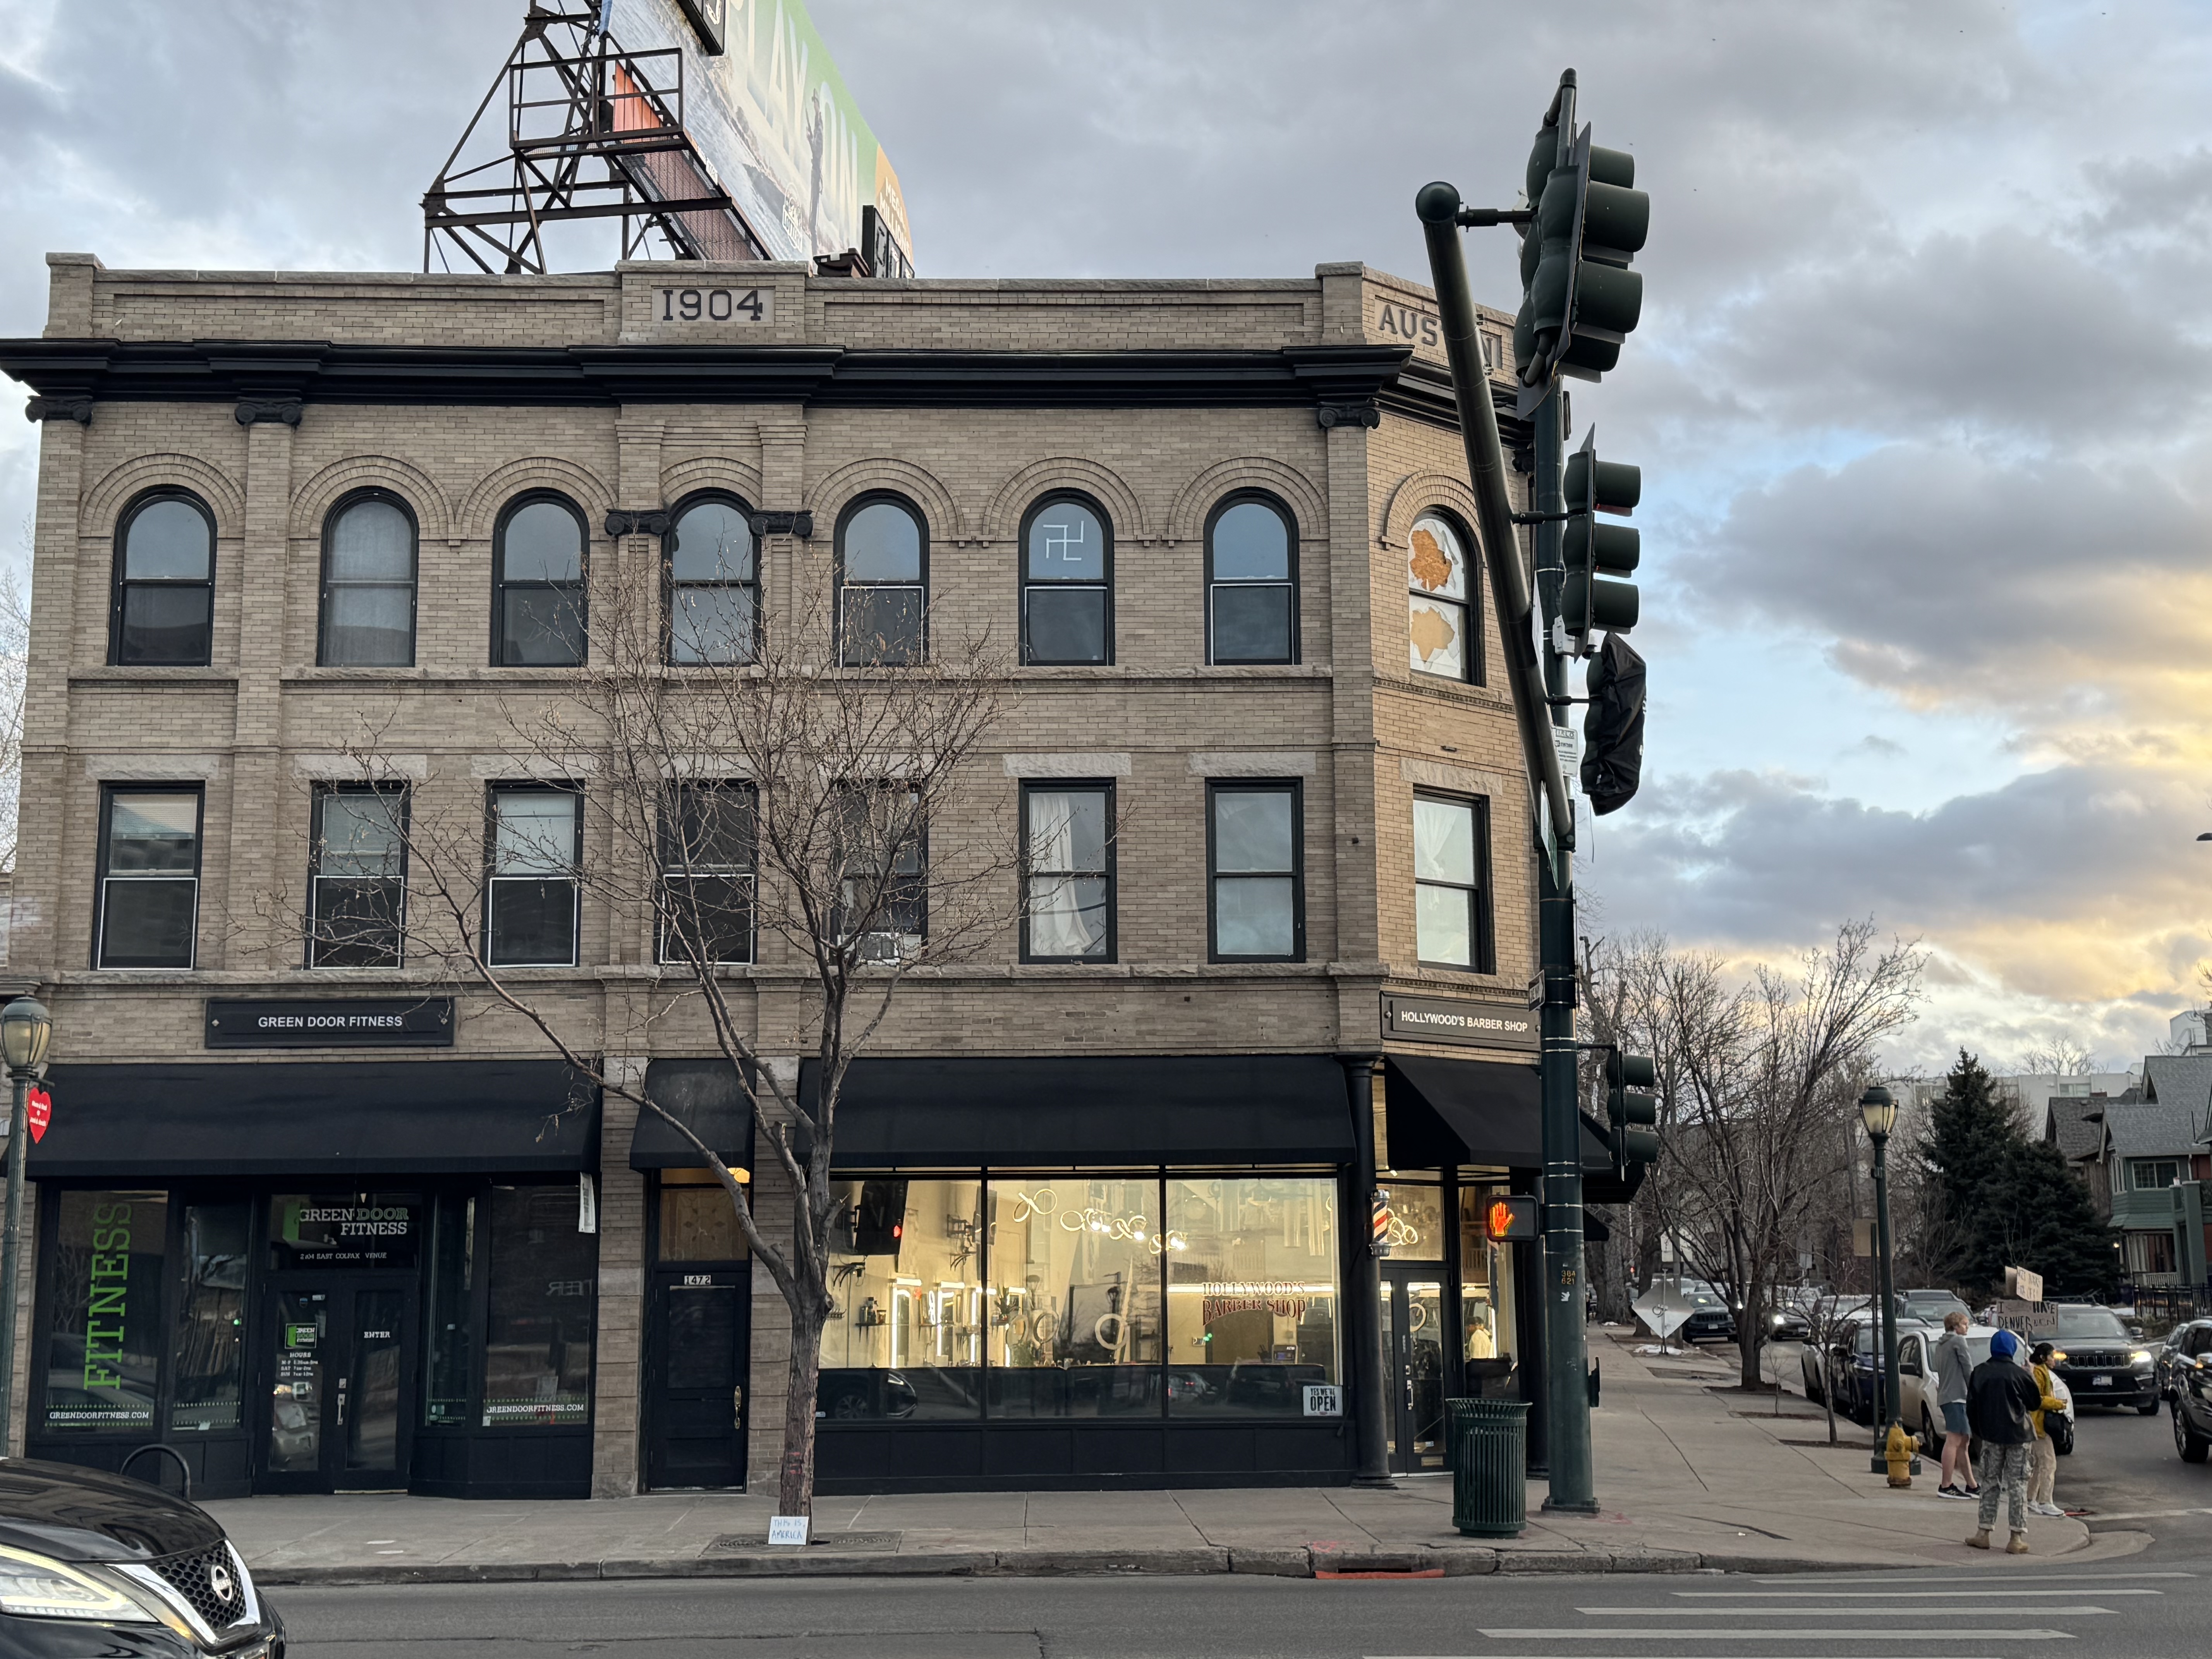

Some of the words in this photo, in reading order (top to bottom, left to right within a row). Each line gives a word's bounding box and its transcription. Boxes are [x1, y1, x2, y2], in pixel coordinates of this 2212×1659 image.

[885, 176, 907, 233] MEGA
[879, 192, 911, 261] MILLIONS
[663, 290, 763, 321] 1904
[1379, 304, 1493, 367] AUSN
[258, 1017, 304, 1028] GREEN
[307, 1017, 345, 1027] DOOR
[349, 1016, 403, 1027] FITNESS
[1401, 1011, 1465, 1026] HOLLYWOOD'S
[1467, 1017, 1503, 1030] BARBER
[1504, 1020, 1528, 1032] SHOP
[299, 1209, 355, 1221] GREEN
[356, 1207, 409, 1220] DOOR
[340, 1222, 407, 1235] FITNESS
[686, 1276, 710, 1285] 1472
[83, 1202, 132, 1390] FITNESS
[1202, 1281, 1305, 1296] HOLLYWOOD'S
[1202, 1298, 1262, 1326] BARBER
[1266, 1298, 1307, 1323] SHOP
[1998, 1316, 2033, 1331] DENVER
[1310, 1388, 1319, 1396] YES
[1310, 1396, 1336, 1412] OPEN
[771, 1529, 802, 1539] AMERICA
